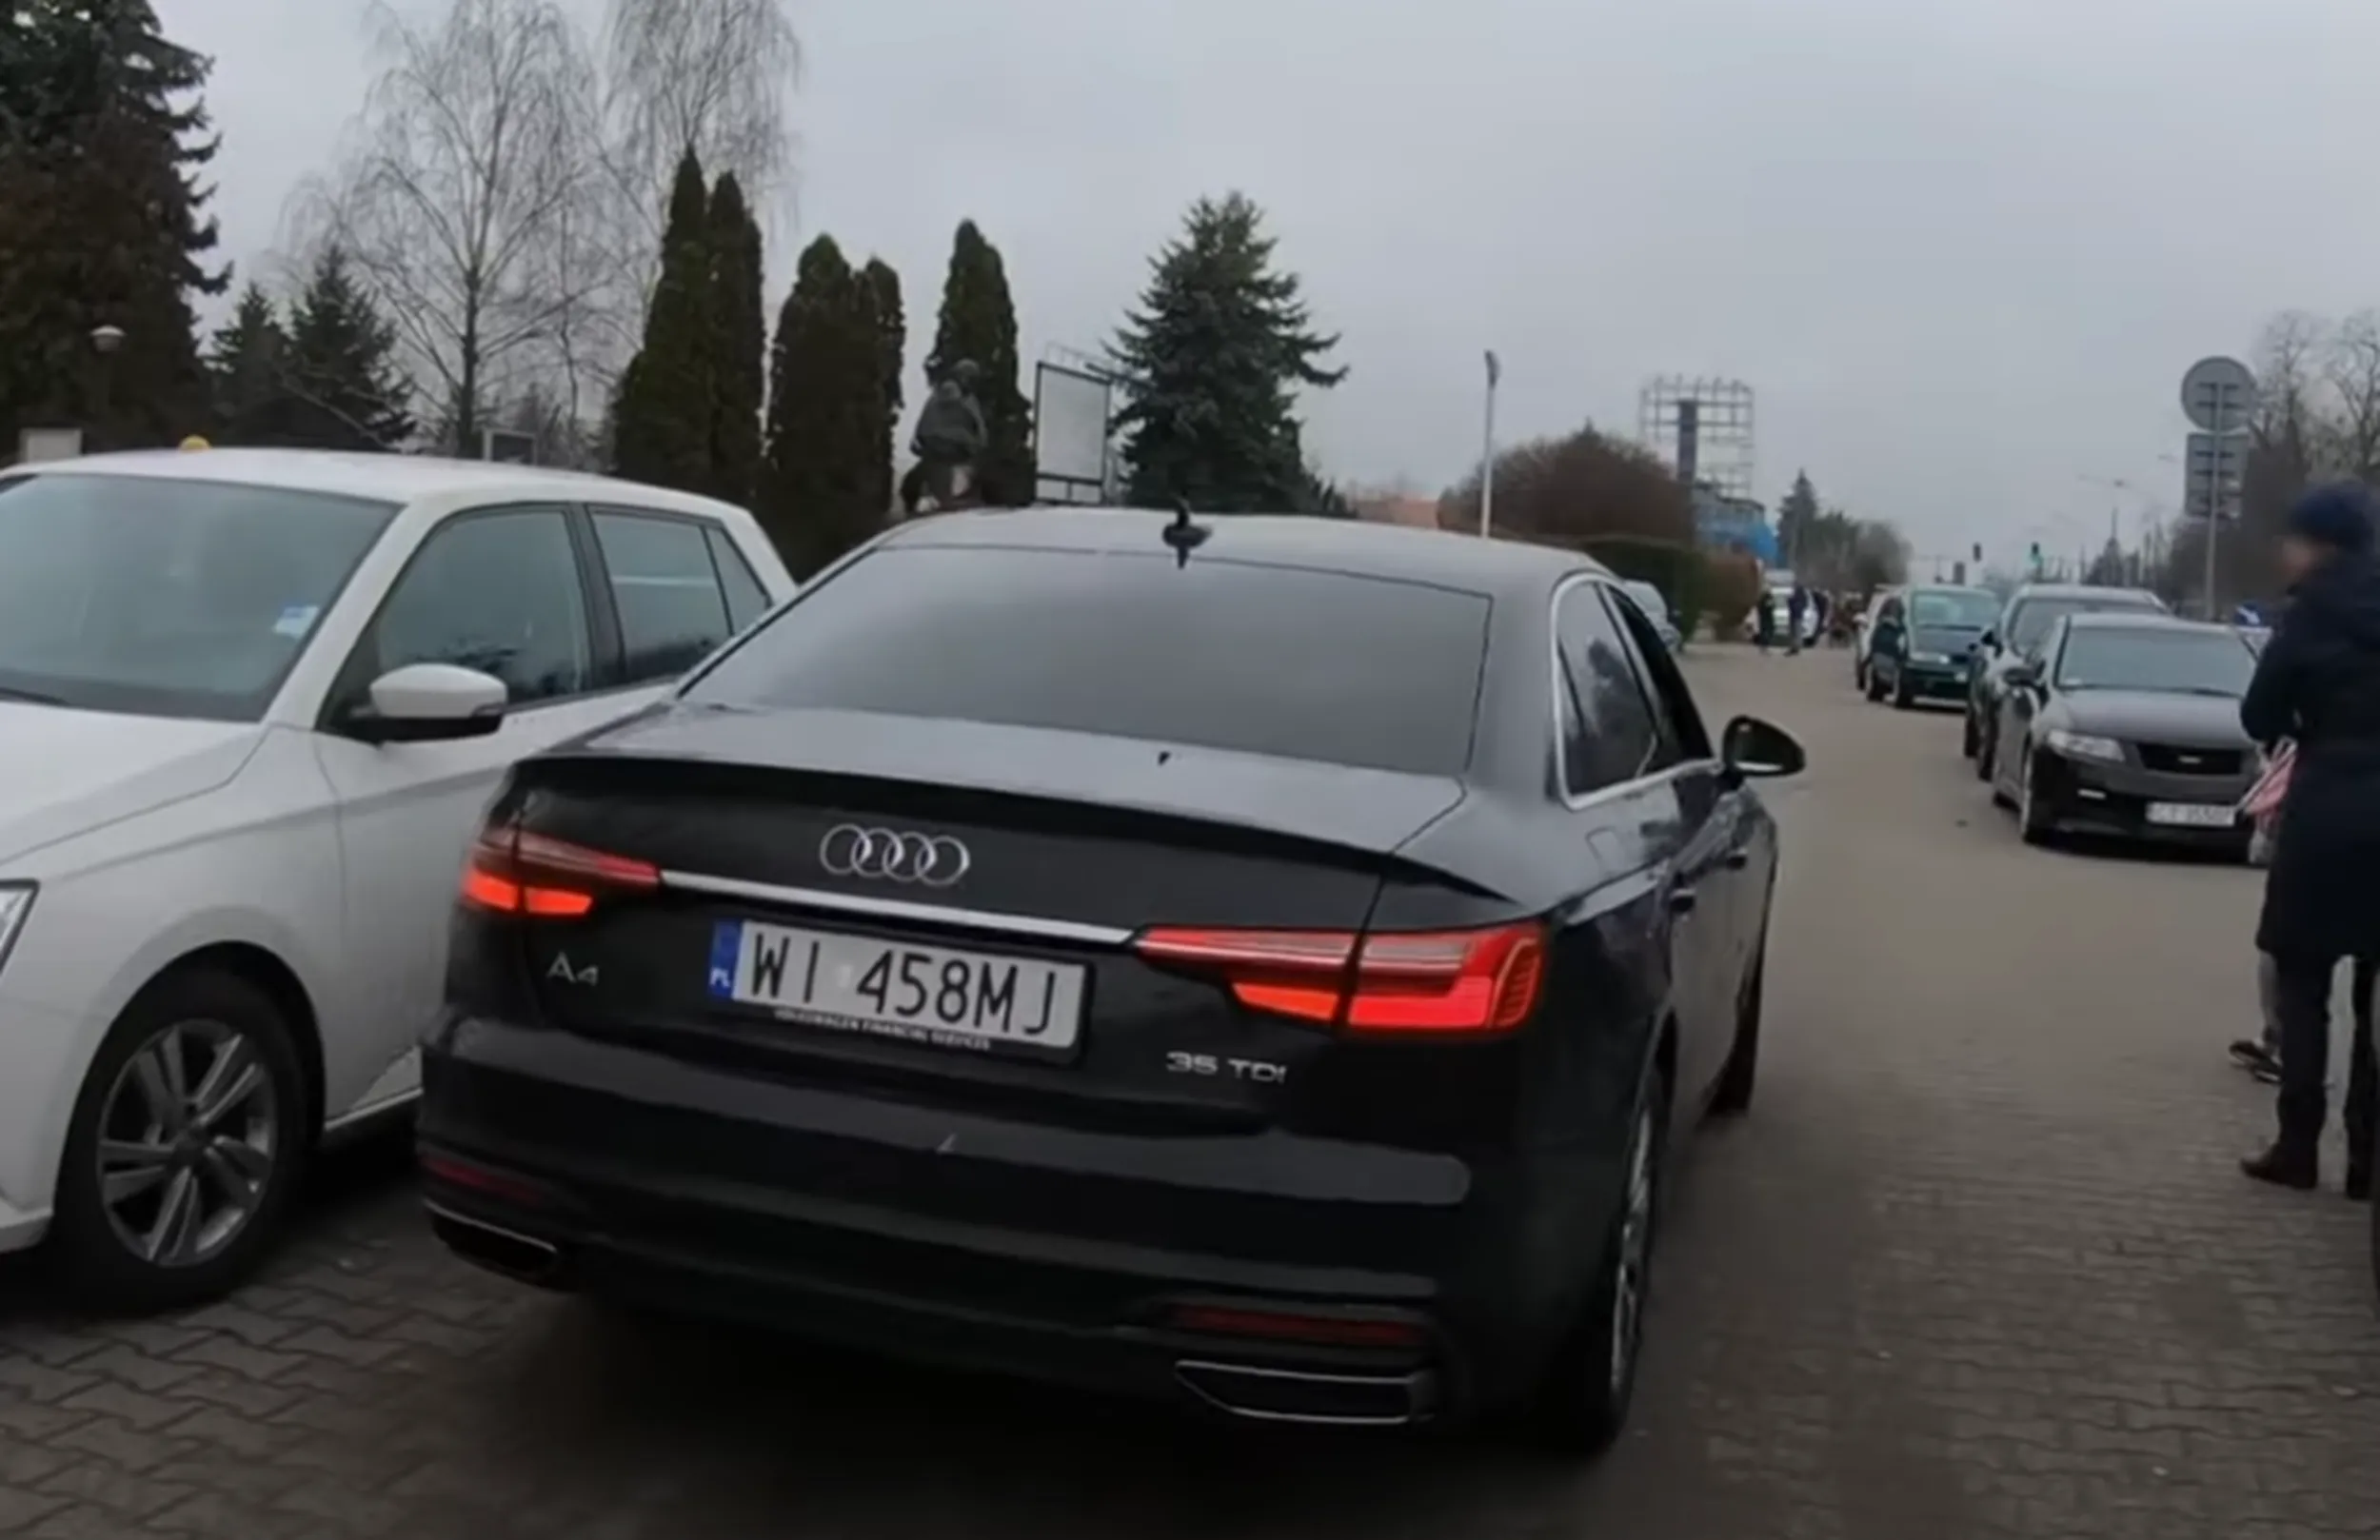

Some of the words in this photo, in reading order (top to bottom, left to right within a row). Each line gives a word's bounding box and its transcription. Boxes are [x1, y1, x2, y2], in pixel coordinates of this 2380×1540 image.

[545, 952, 600, 986] A4
[751, 933, 821, 1004] WI
[857, 950, 1057, 1036] 458MJ
[1165, 1051, 1219, 1076] 35
[1227, 1058, 1287, 1085] TDI
